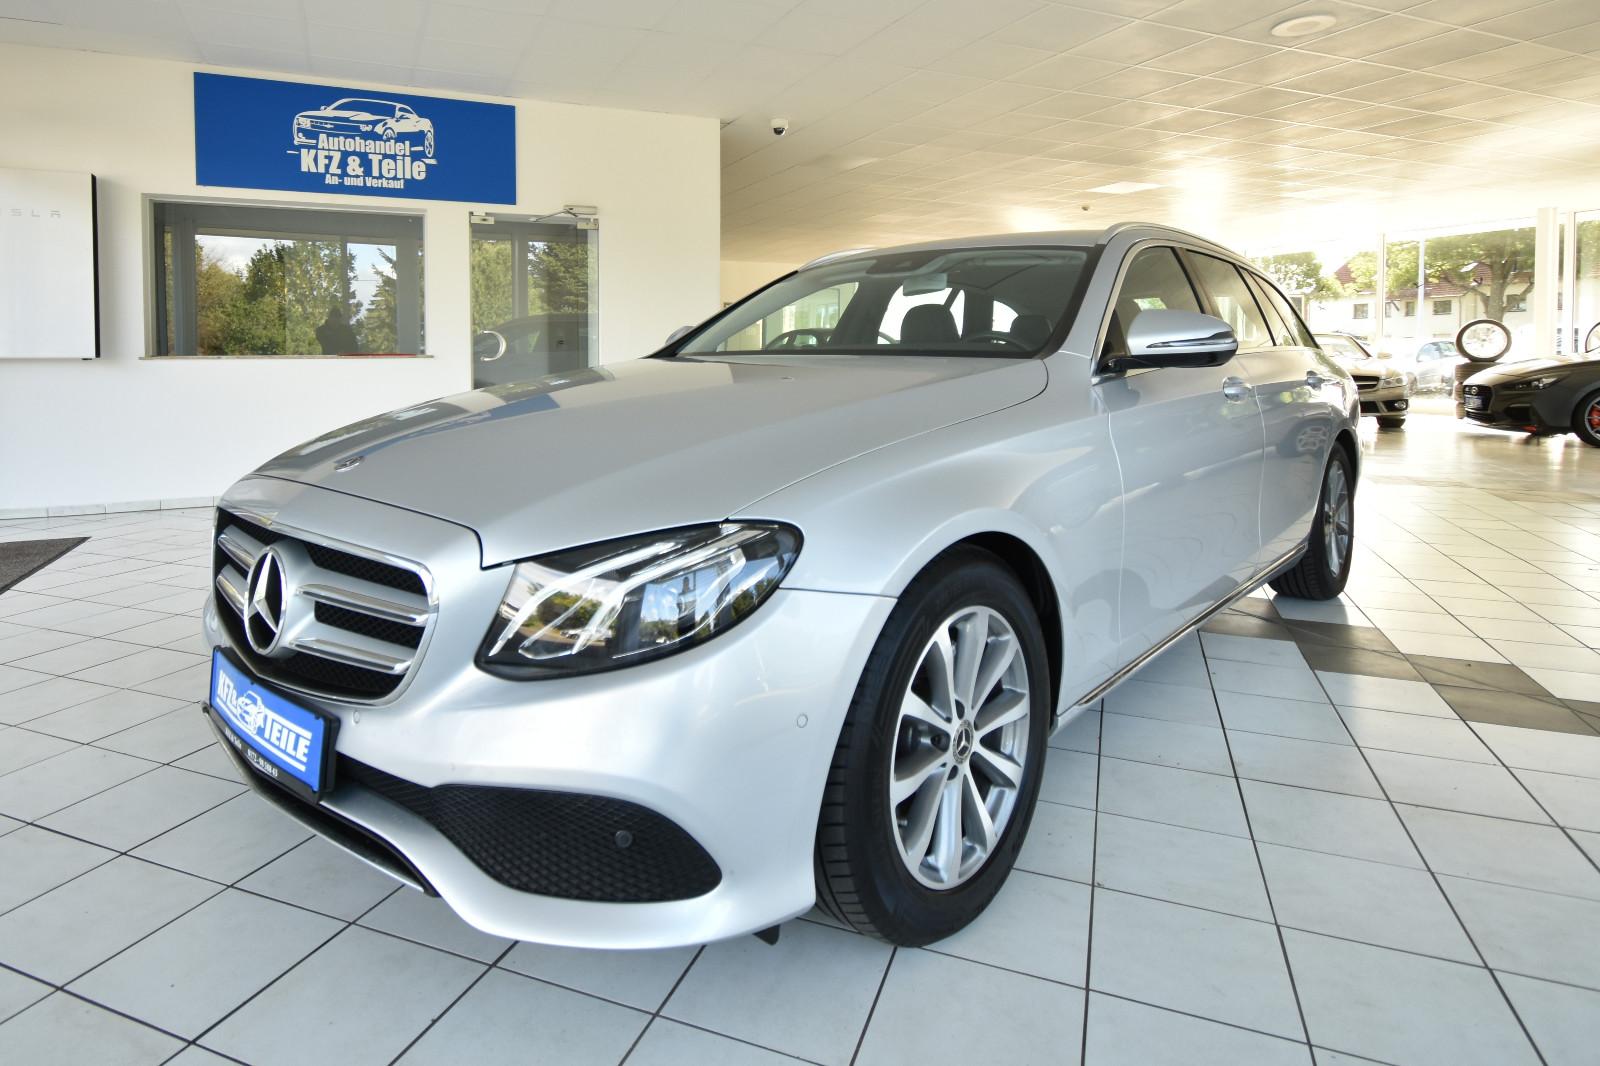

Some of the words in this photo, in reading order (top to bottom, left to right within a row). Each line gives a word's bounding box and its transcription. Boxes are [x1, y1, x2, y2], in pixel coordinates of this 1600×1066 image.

[318, 133, 410, 156] Autohandel
[300, 148, 342, 175] KFZ
[346, 155, 364, 176] &
[368, 153, 426, 180] Teile
[325, 174, 342, 185] An-
[343, 176, 364, 187] und
[365, 176, 404, 189] Verkauf
[261, 706, 312, 763] TEILE
